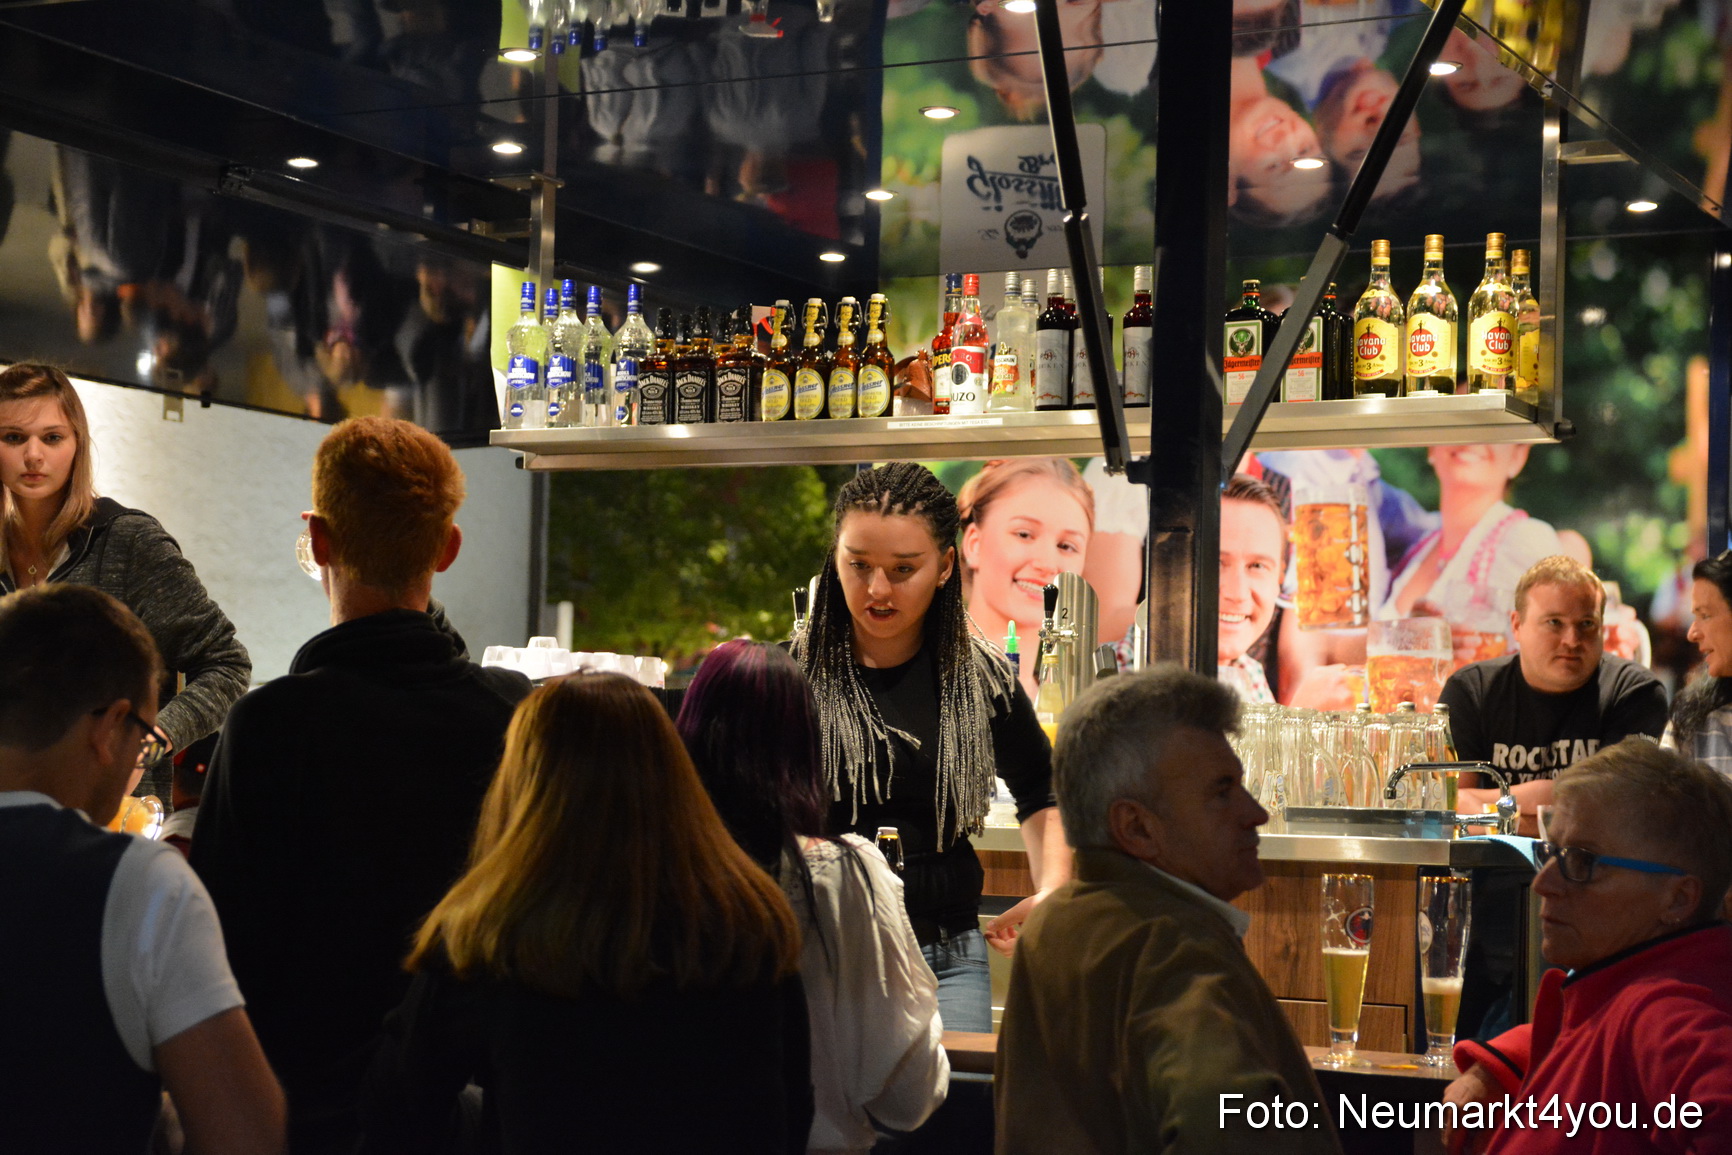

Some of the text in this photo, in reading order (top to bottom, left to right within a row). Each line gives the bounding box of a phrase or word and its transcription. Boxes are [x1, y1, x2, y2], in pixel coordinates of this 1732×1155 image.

[1411, 343, 1430, 353] Club
[1488, 340, 1509, 350] Club
[1359, 346, 1378, 356] Club
[1224, 358, 1260, 369] Jägermeister
[1291, 355, 1321, 365] germeister
[951, 391, 976, 402] UZO
[1061, 607, 1069, 620] 2
